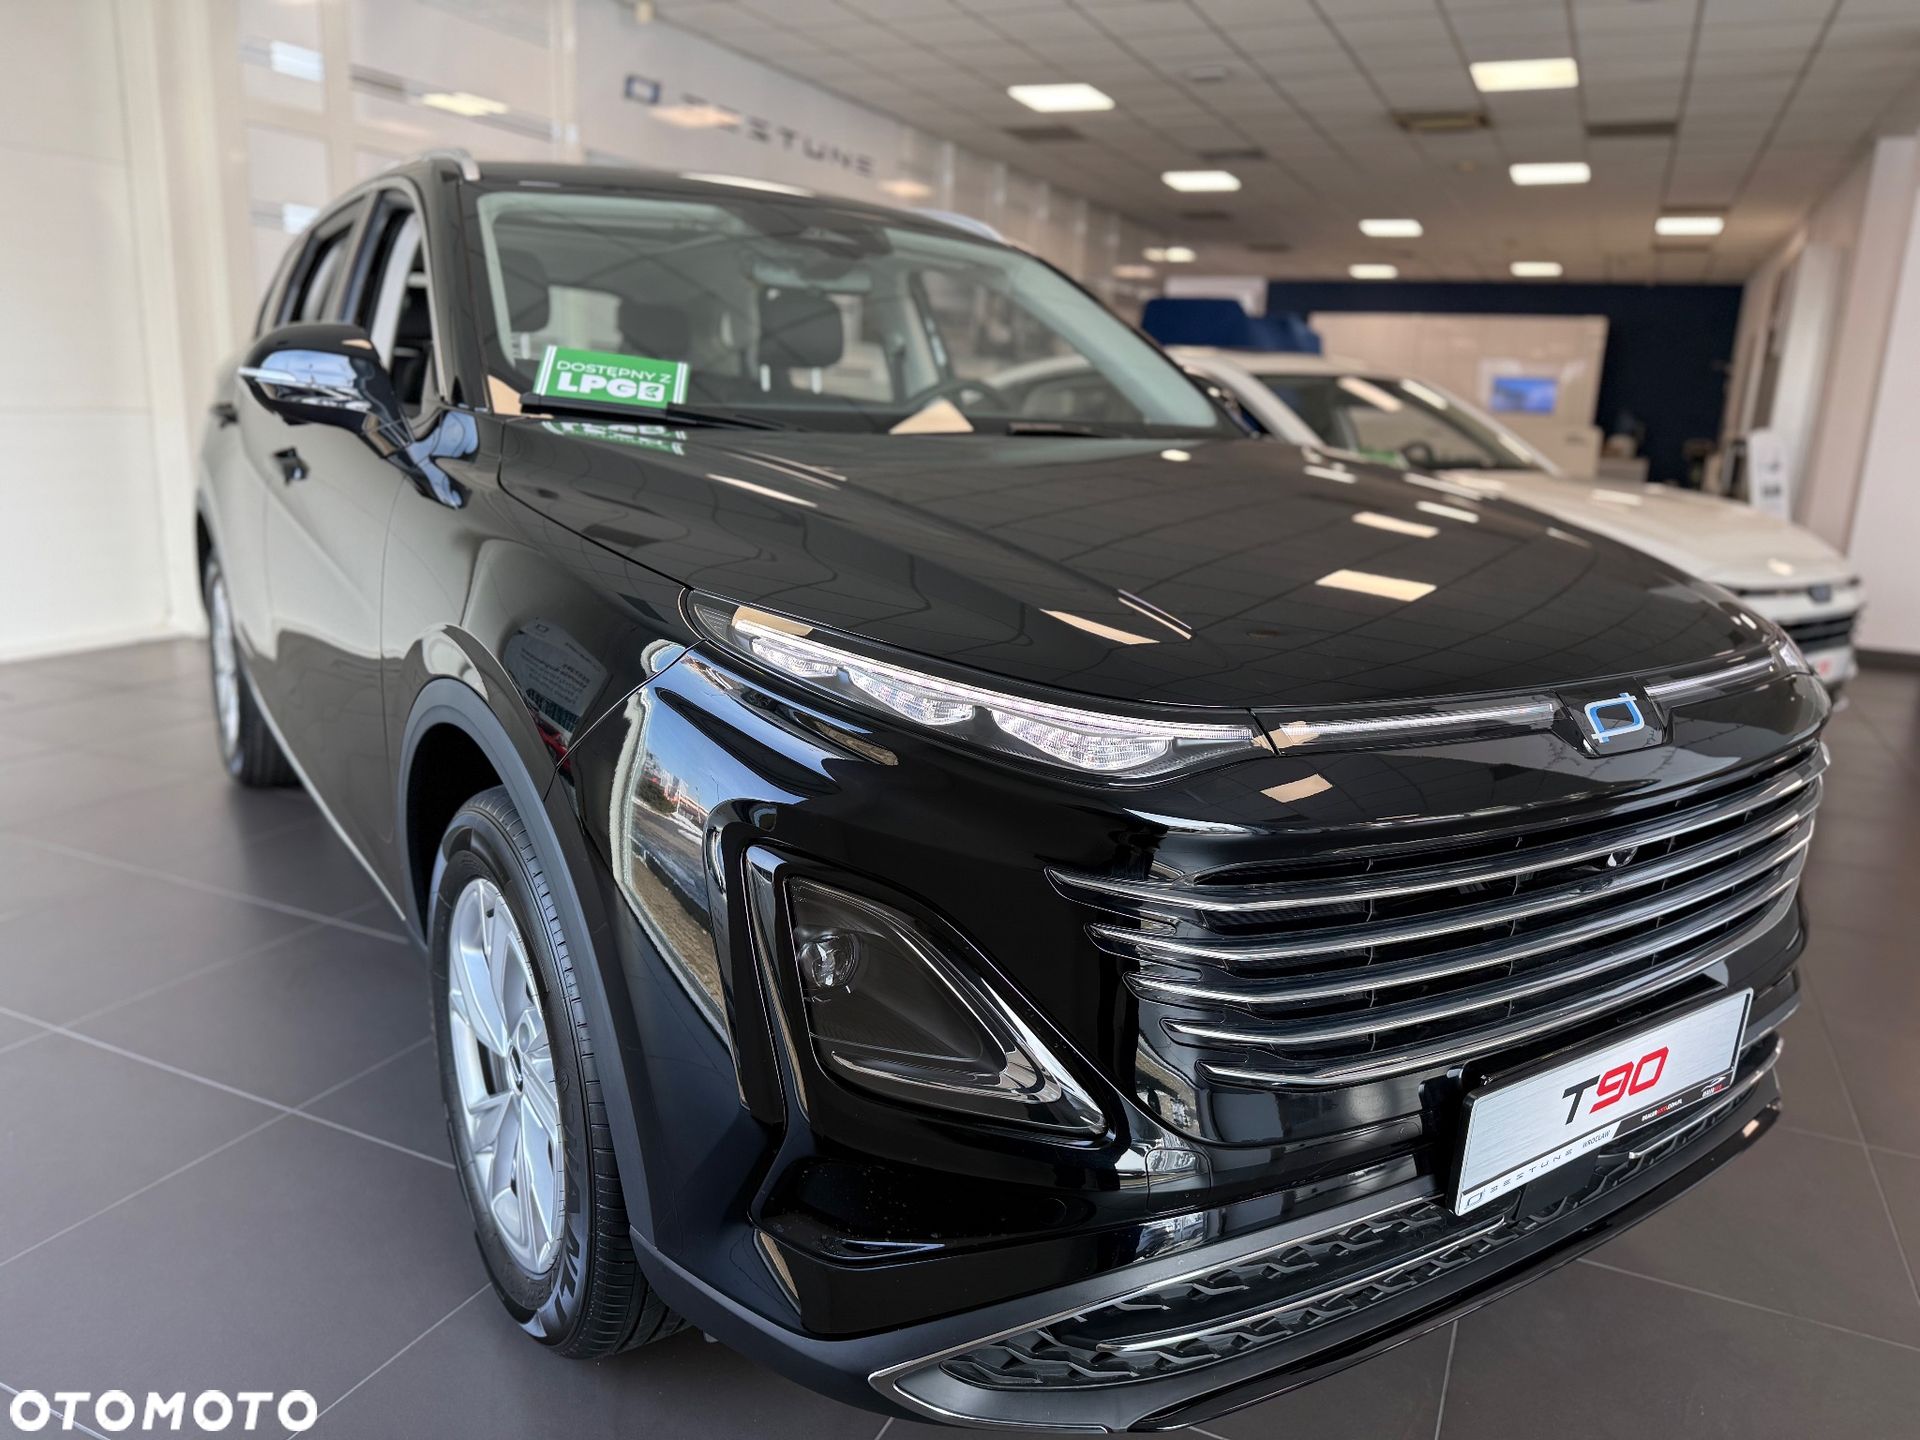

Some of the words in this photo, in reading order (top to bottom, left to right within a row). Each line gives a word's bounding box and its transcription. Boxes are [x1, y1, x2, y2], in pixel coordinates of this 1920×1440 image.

[557, 360, 656, 381] DOSTĘPNY
[659, 373, 673, 385] Z
[1562, 1046, 1669, 1125] T90
